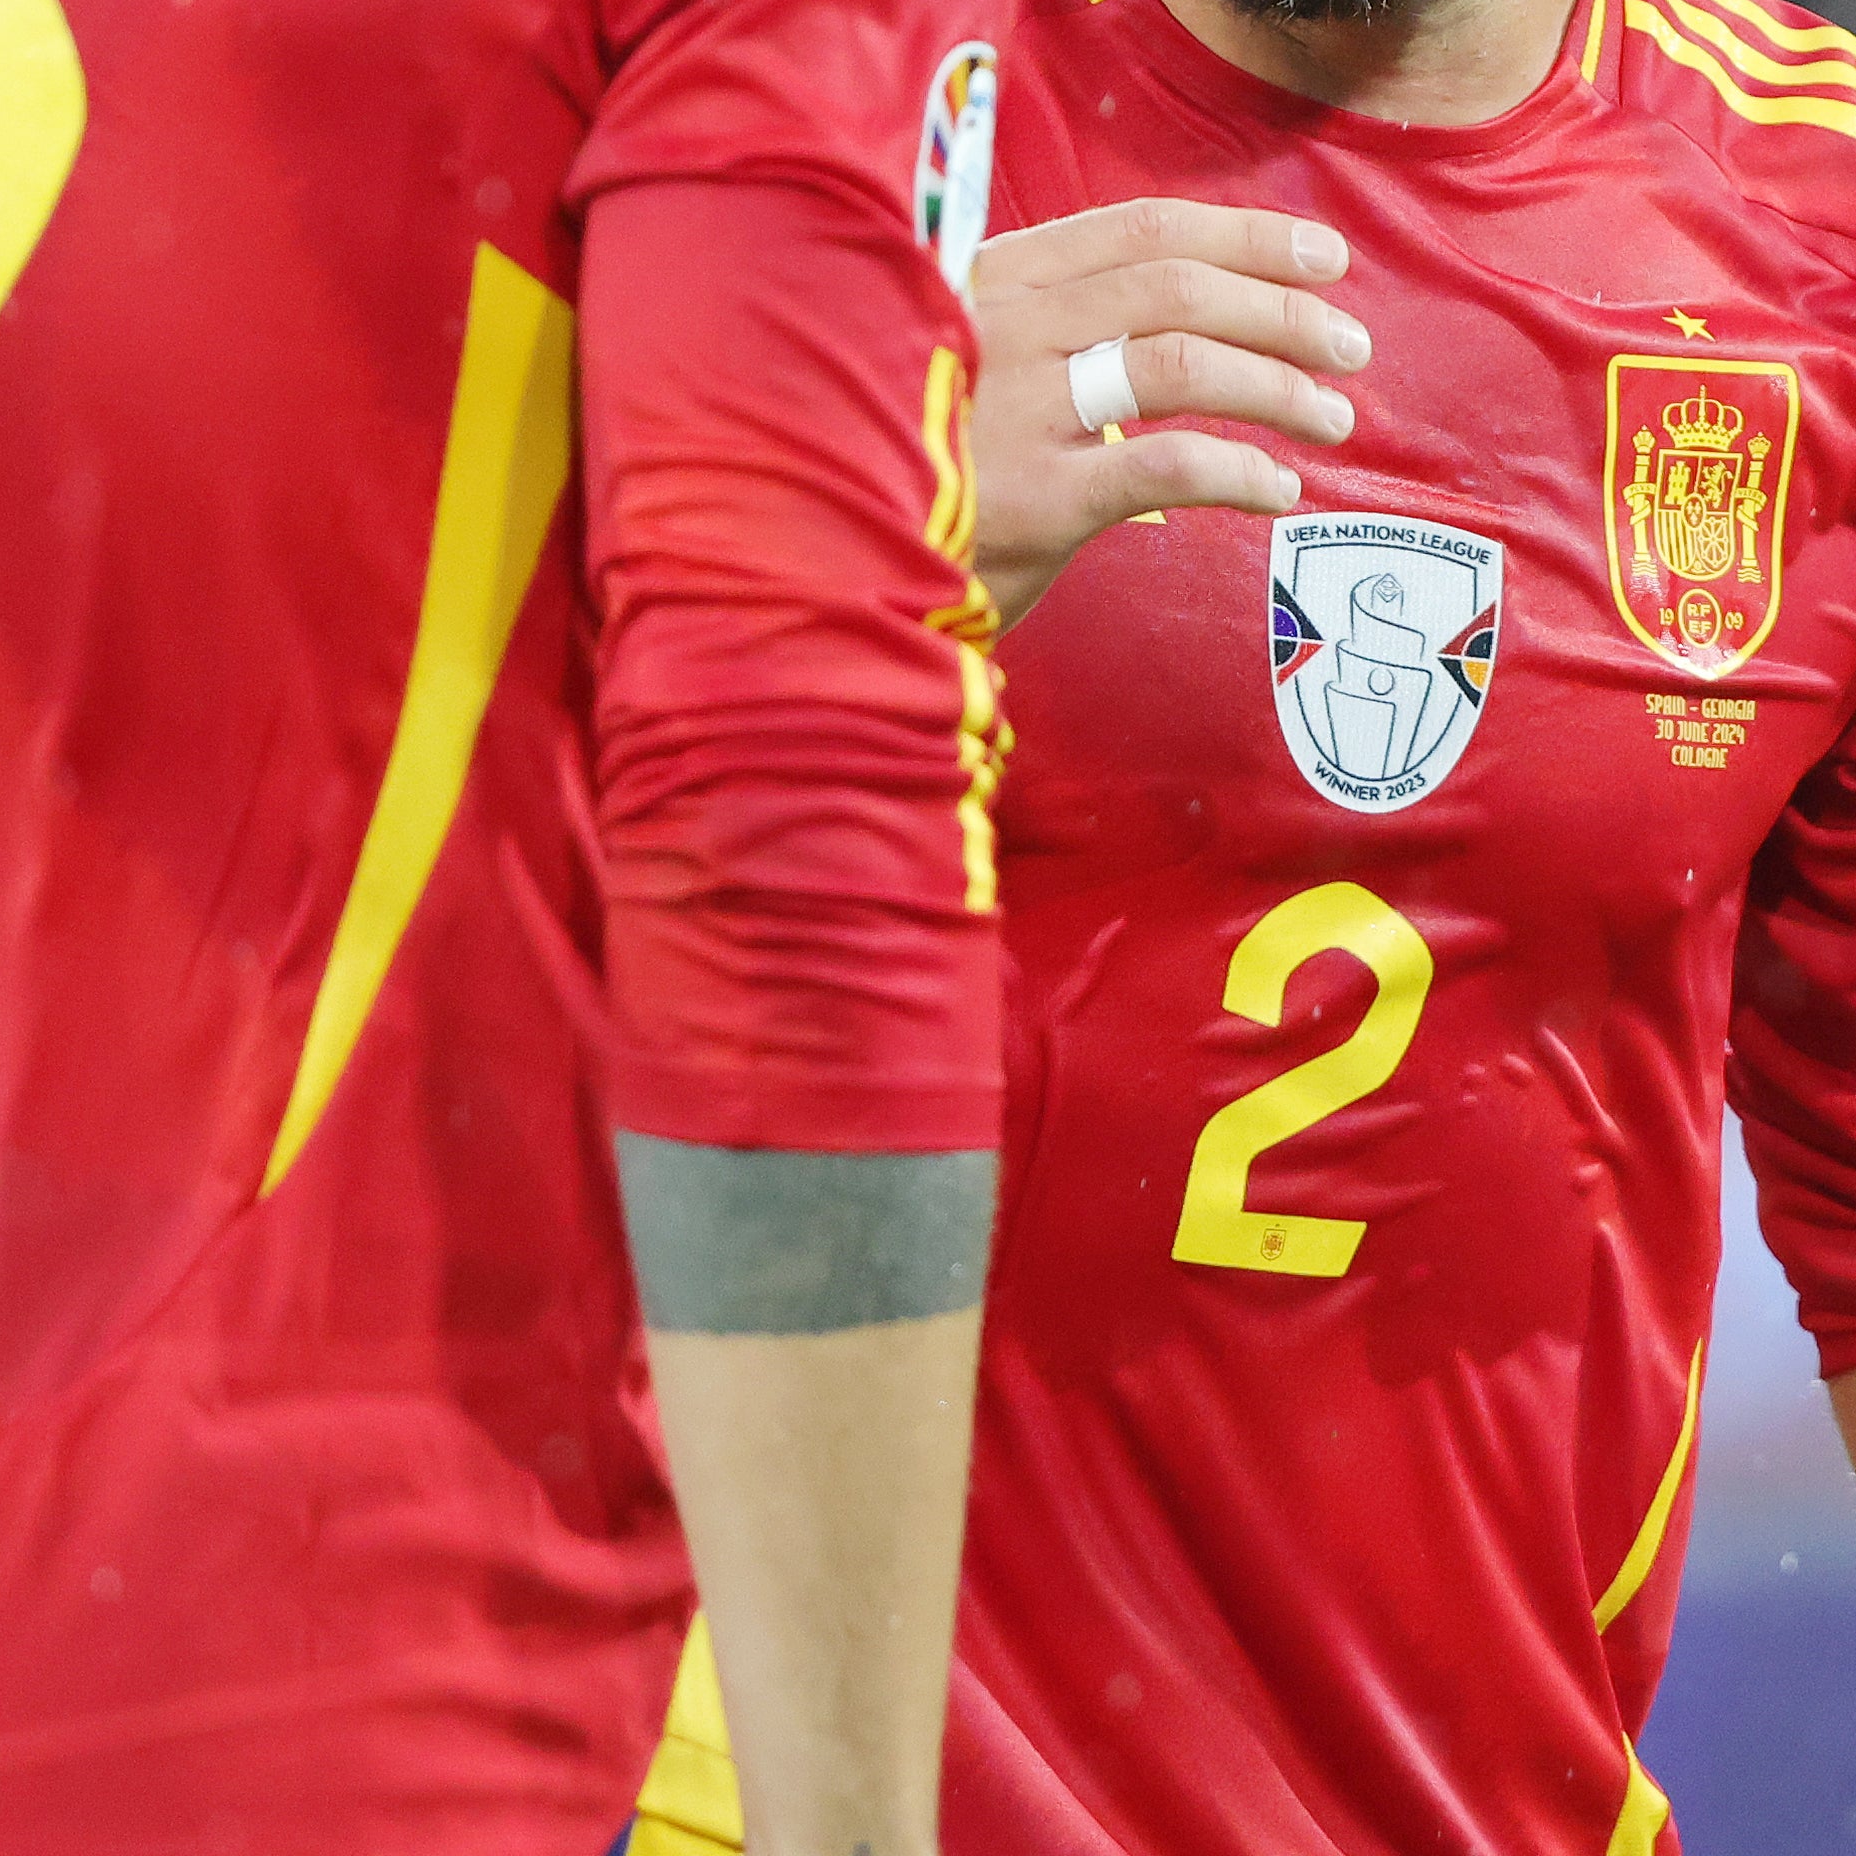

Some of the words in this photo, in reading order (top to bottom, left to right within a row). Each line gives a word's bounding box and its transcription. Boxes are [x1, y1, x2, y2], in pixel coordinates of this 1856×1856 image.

[1286, 524, 1331, 543] UEFA
[1335, 524, 1416, 544] NATIONS
[1420, 532, 1493, 565] LEAGUE
[1659, 607, 1675, 626] 19
[1724, 612, 1744, 630] 09
[1687, 603, 1711, 617] RF
[1688, 620, 1712, 634] EF
[1645, 694, 1687, 716] SPAIN
[1701, 698, 1756, 720] GEORGIA
[1654, 719, 1675, 740] 30
[1677, 720, 1710, 743] JUNE
[1712, 723, 1746, 745] 2024
[1671, 745, 1729, 769] COLOGNE
[1314, 761, 1381, 801] WINNER
[1387, 773, 1427, 801] 2023
[1171, 881, 1435, 1278] 2
